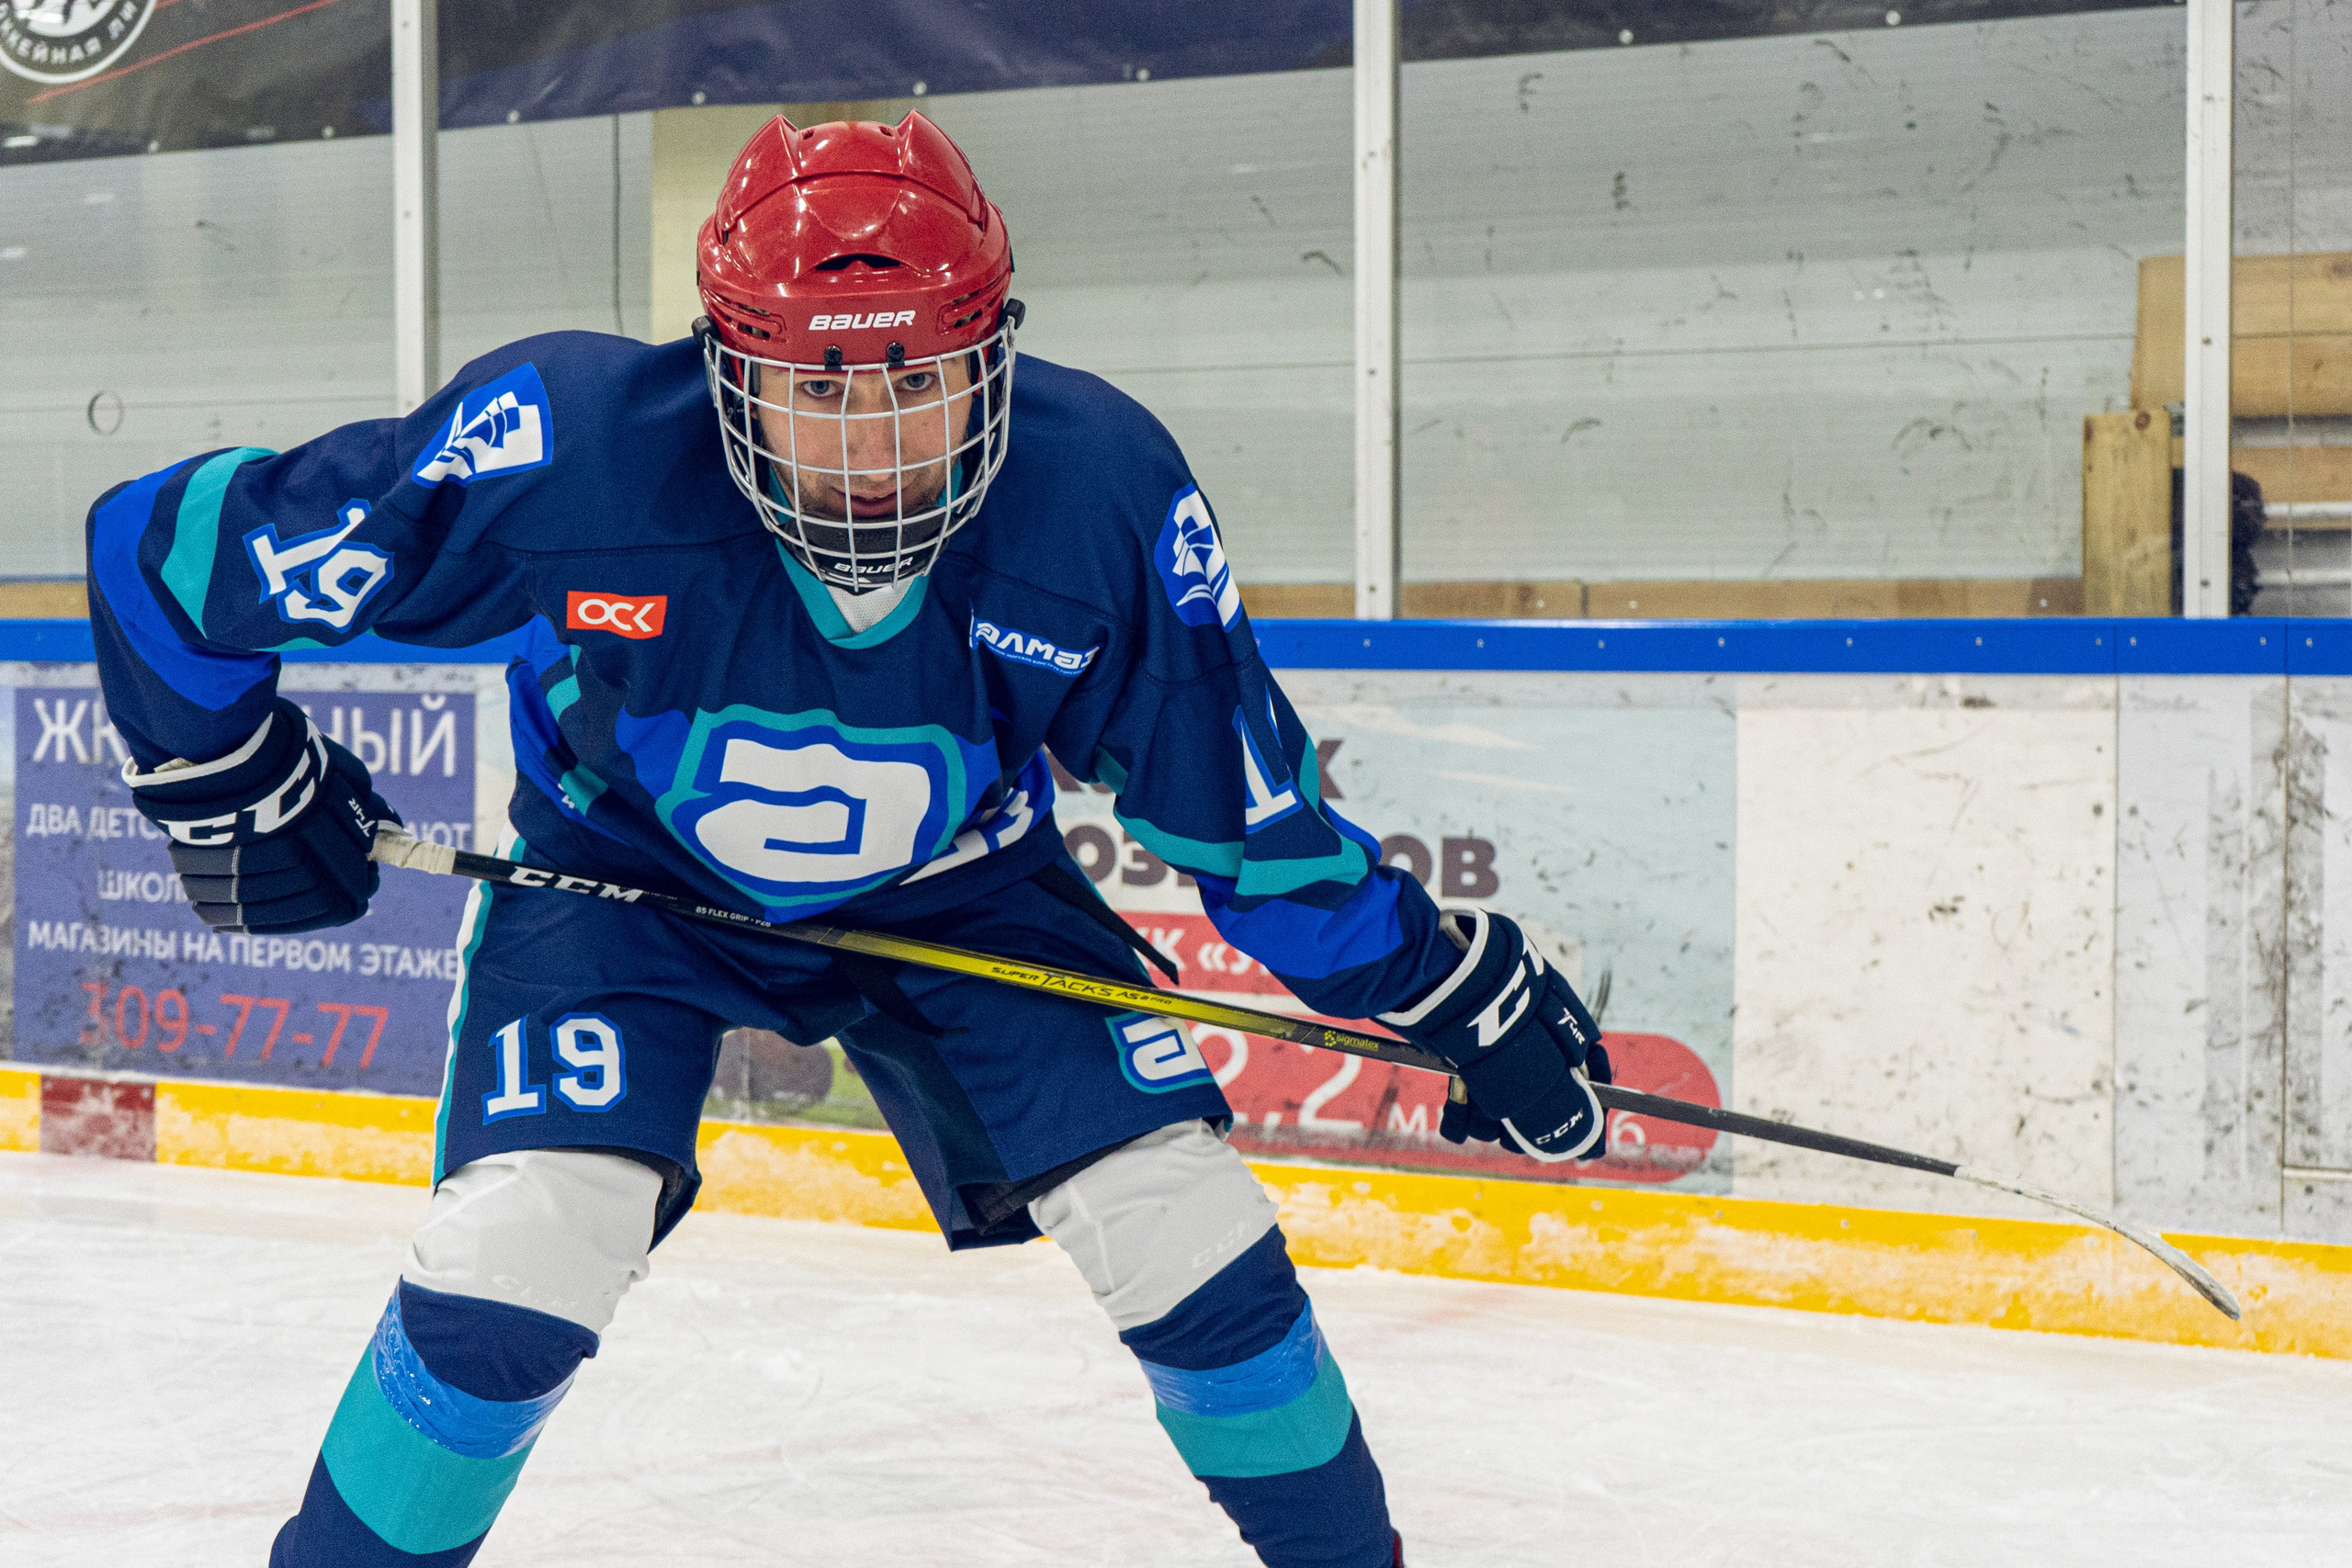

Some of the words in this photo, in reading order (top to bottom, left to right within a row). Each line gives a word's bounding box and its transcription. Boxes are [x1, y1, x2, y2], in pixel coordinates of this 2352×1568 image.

[808, 310, 916, 331] BAUER
[27, 804, 81, 836] ДВА
[509, 865, 644, 903] CCM
[695, 906, 707, 915] 85
[707, 908, 729, 919] FLEX
[729, 912, 750, 922] GRIP
[28, 920, 176, 960] МАГАЗИНЫ
[184, 931, 226, 961] НА
[230, 936, 351, 972] ПЕРВОМ
[358, 943, 458, 980] ЭТАЖЕ
[991, 965, 1040, 983] SUPER
[1041, 972, 1114, 997] TACKS
[481, 1011, 628, 1126] 19
[1534, 1108, 1584, 1145] CCM
